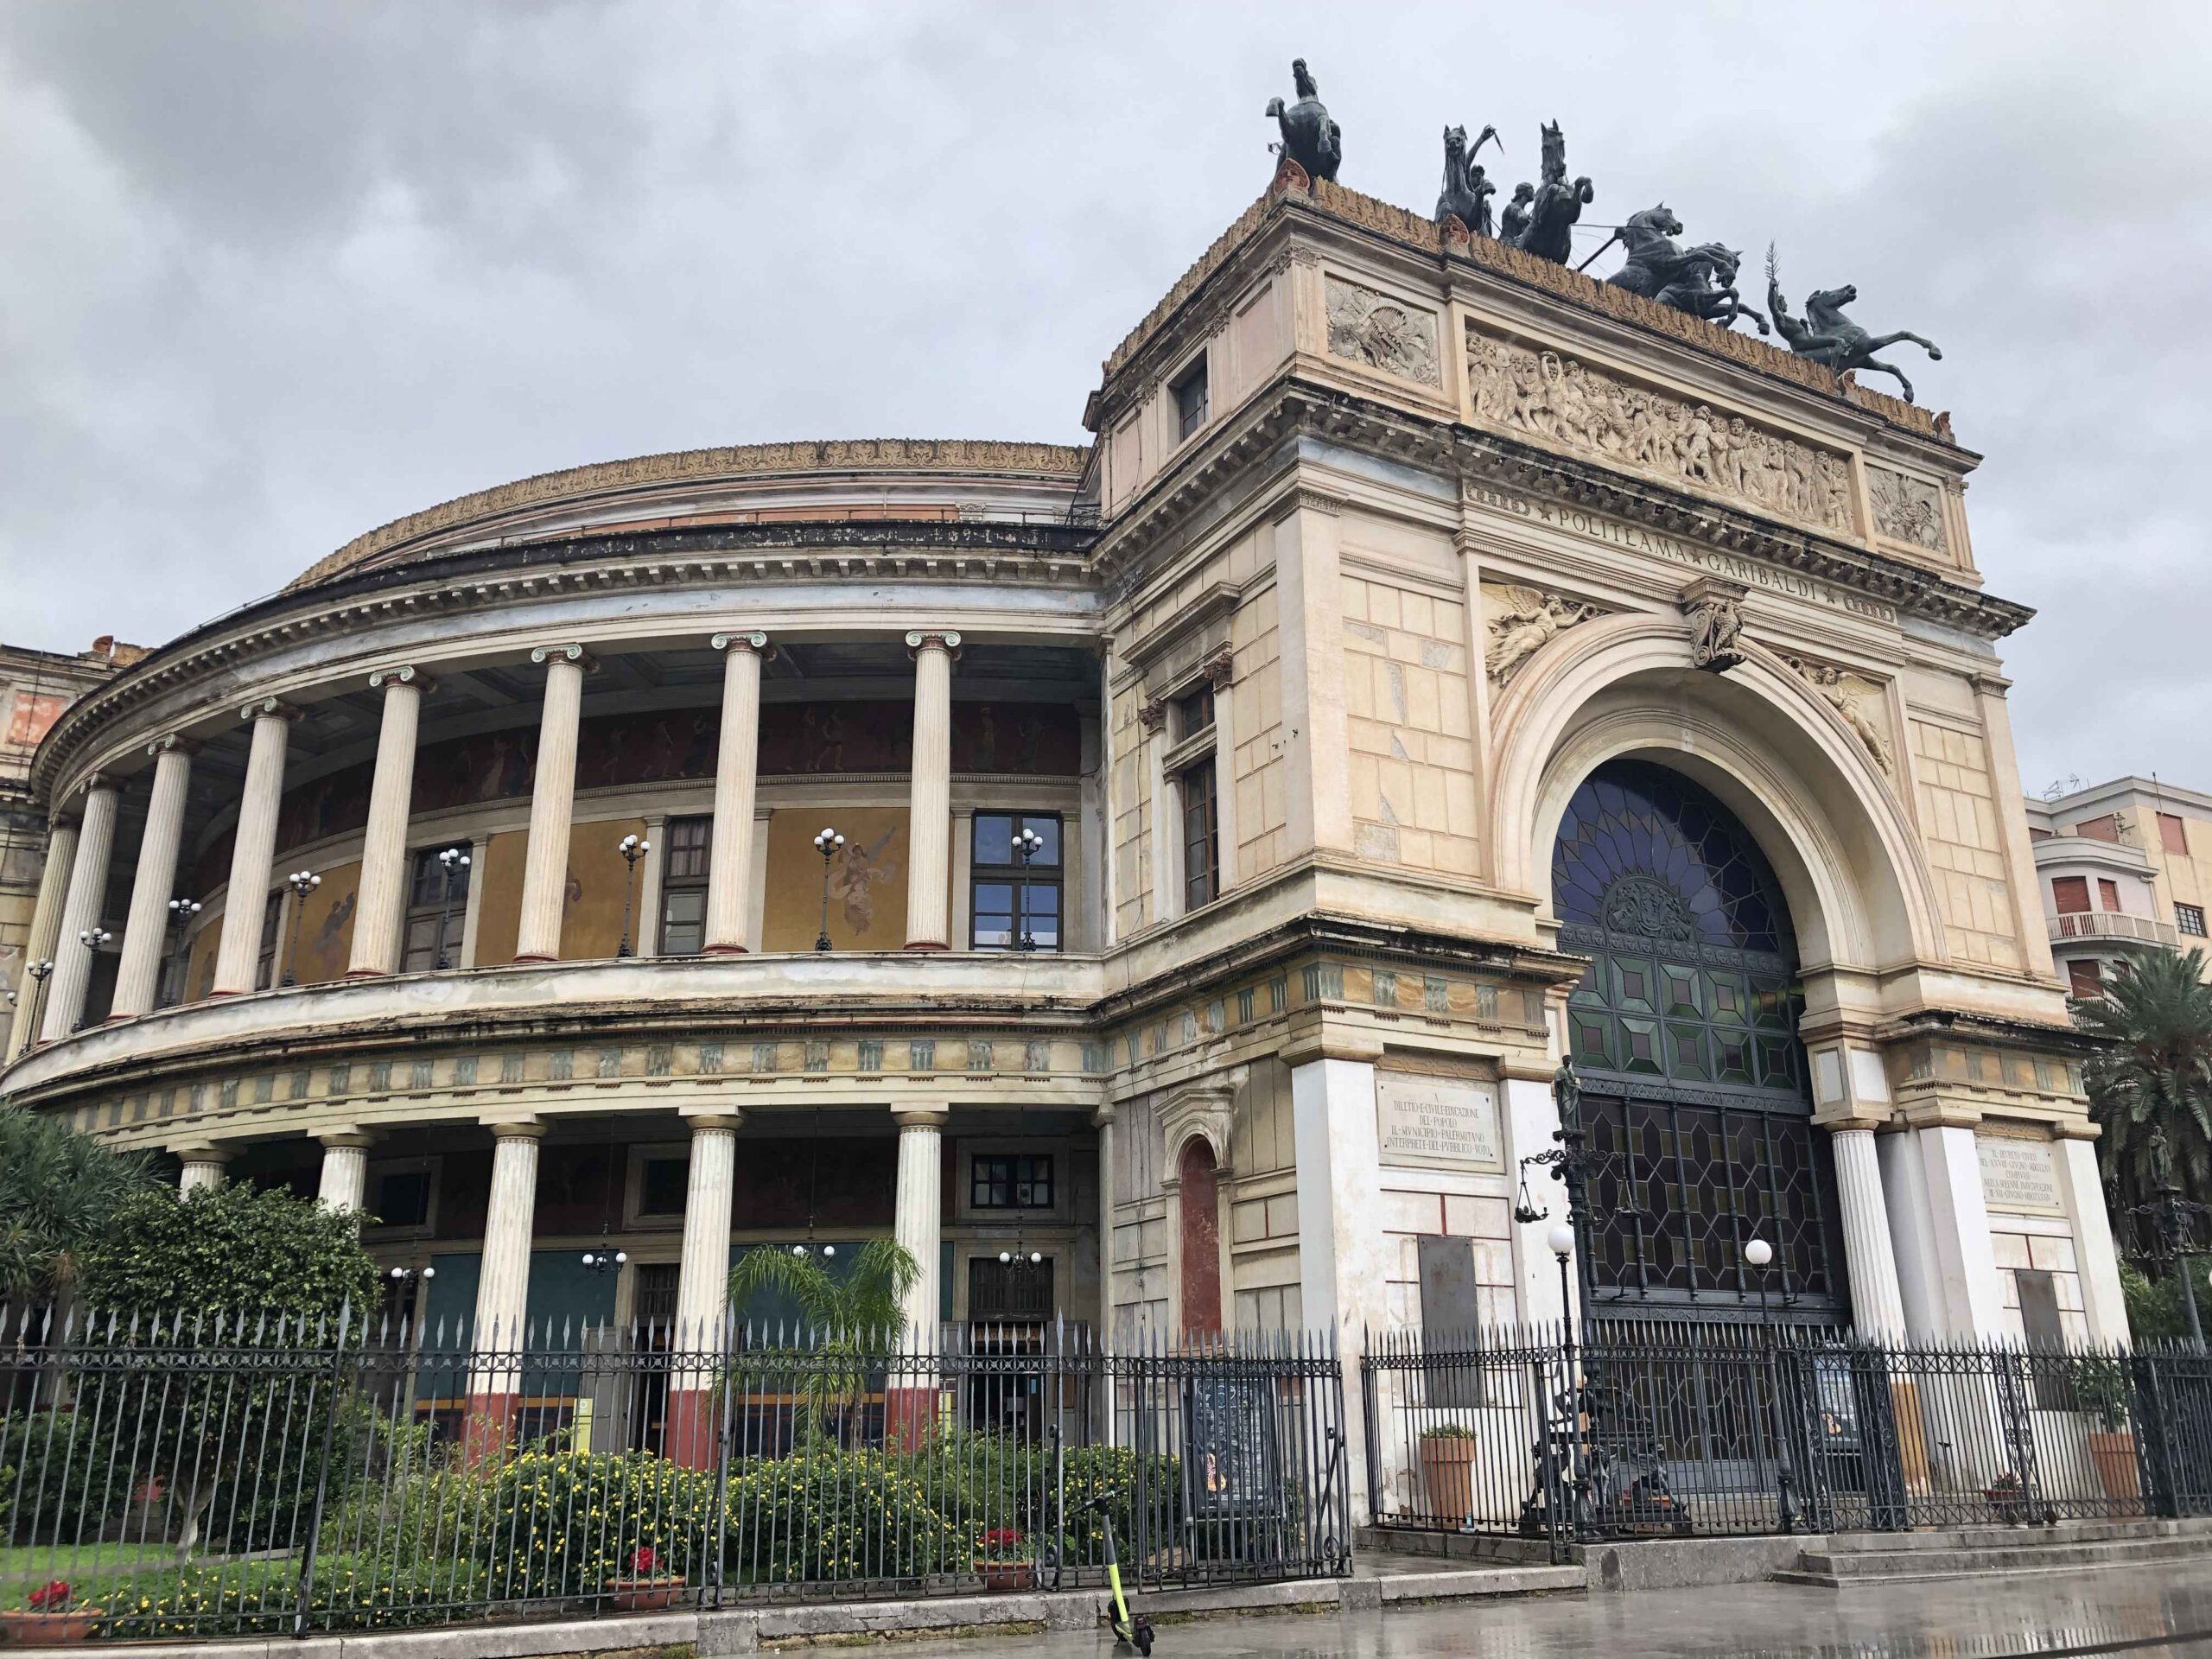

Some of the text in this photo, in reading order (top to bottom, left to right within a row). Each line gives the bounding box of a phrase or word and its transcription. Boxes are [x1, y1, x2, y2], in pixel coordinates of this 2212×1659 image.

[1558, 508, 1816, 600] POLITEAMA GARIBALDI
[1425, 1103, 1444, 1115] CIVILE
[1419, 1116, 1457, 1128] DEL POPOLO
[1391, 1125, 1484, 1142] IL MVNICIPIO PALERMITANO
[1387, 1136, 1490, 1155] INTERPRETE DEL PVBBLICO VOTO
